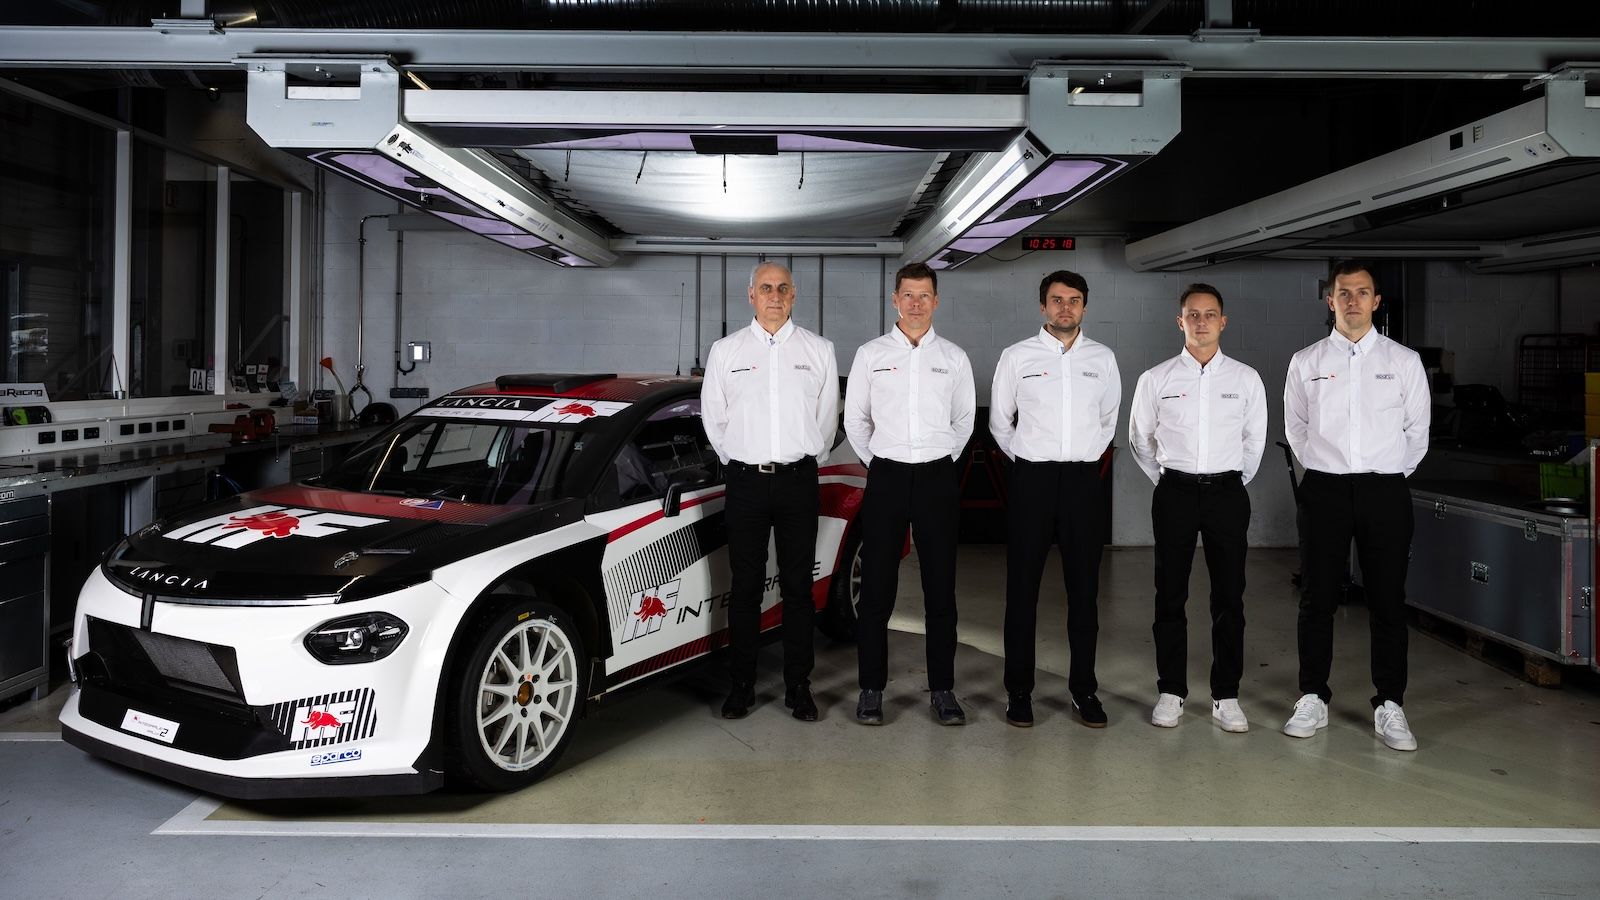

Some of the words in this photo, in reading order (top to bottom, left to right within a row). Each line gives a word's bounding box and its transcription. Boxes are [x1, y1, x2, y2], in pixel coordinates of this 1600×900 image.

[1030, 239, 1040, 249] 10
[1042, 239, 1056, 249] 25
[1062, 239, 1073, 249] 18
[436, 398, 521, 408] LANCIA
[129, 566, 209, 589] LANCIA
[676, 561, 821, 625] INTERAE
[159, 728, 169, 738] 2
